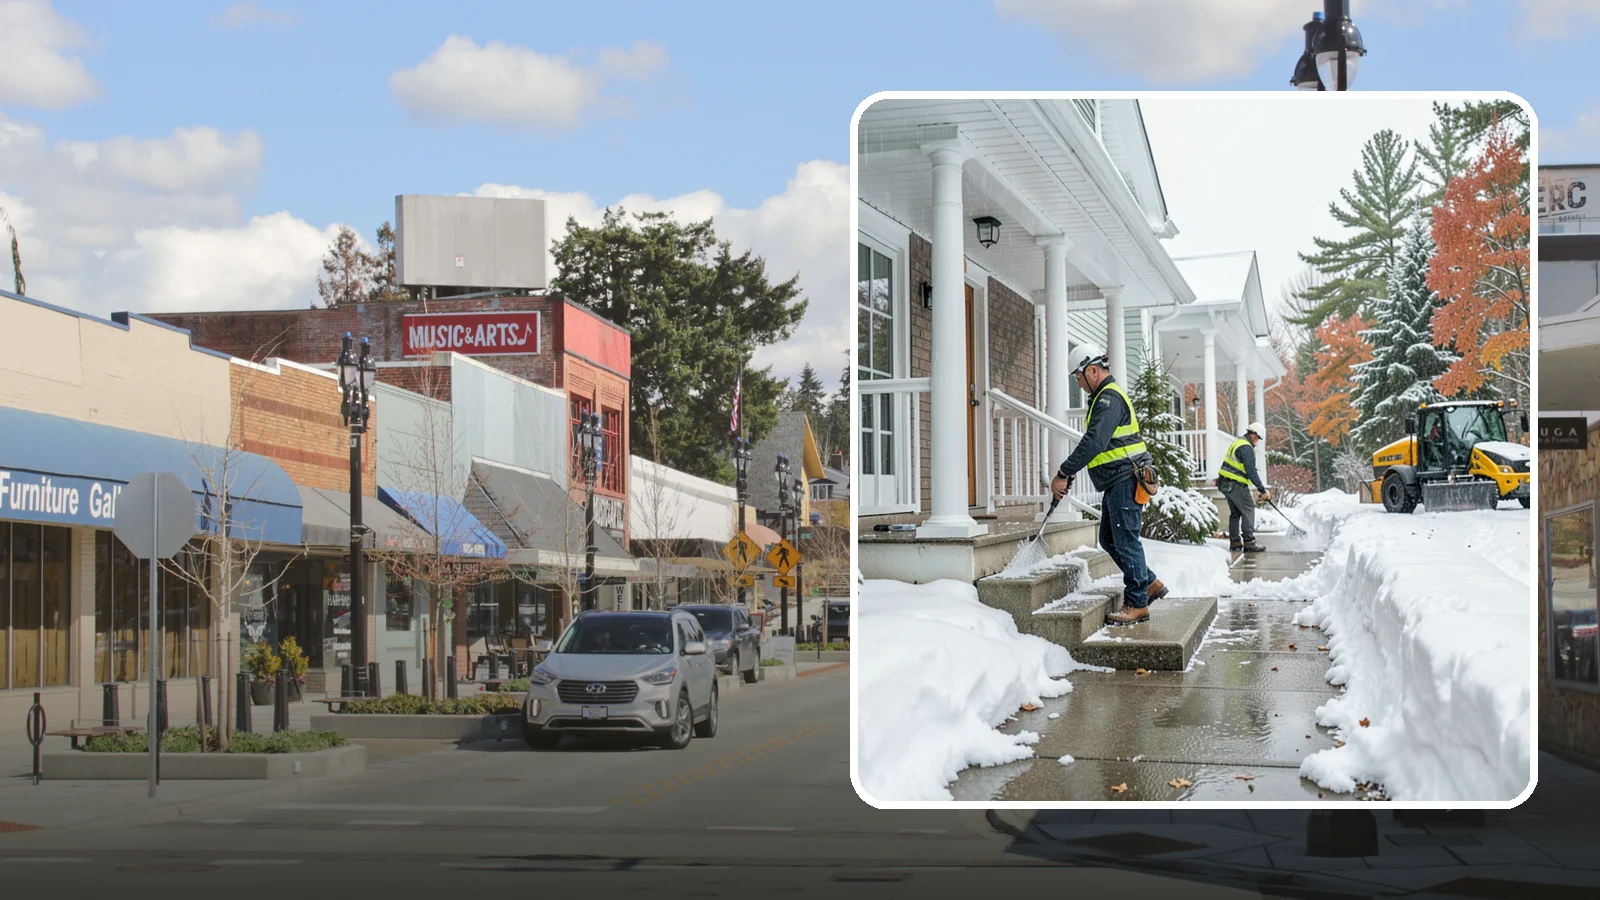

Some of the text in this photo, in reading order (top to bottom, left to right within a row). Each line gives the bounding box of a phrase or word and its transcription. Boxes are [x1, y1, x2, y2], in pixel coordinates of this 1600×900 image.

[0, 471, 121, 519] Furniture Gal
[454, 563, 479, 575] SUSHI
